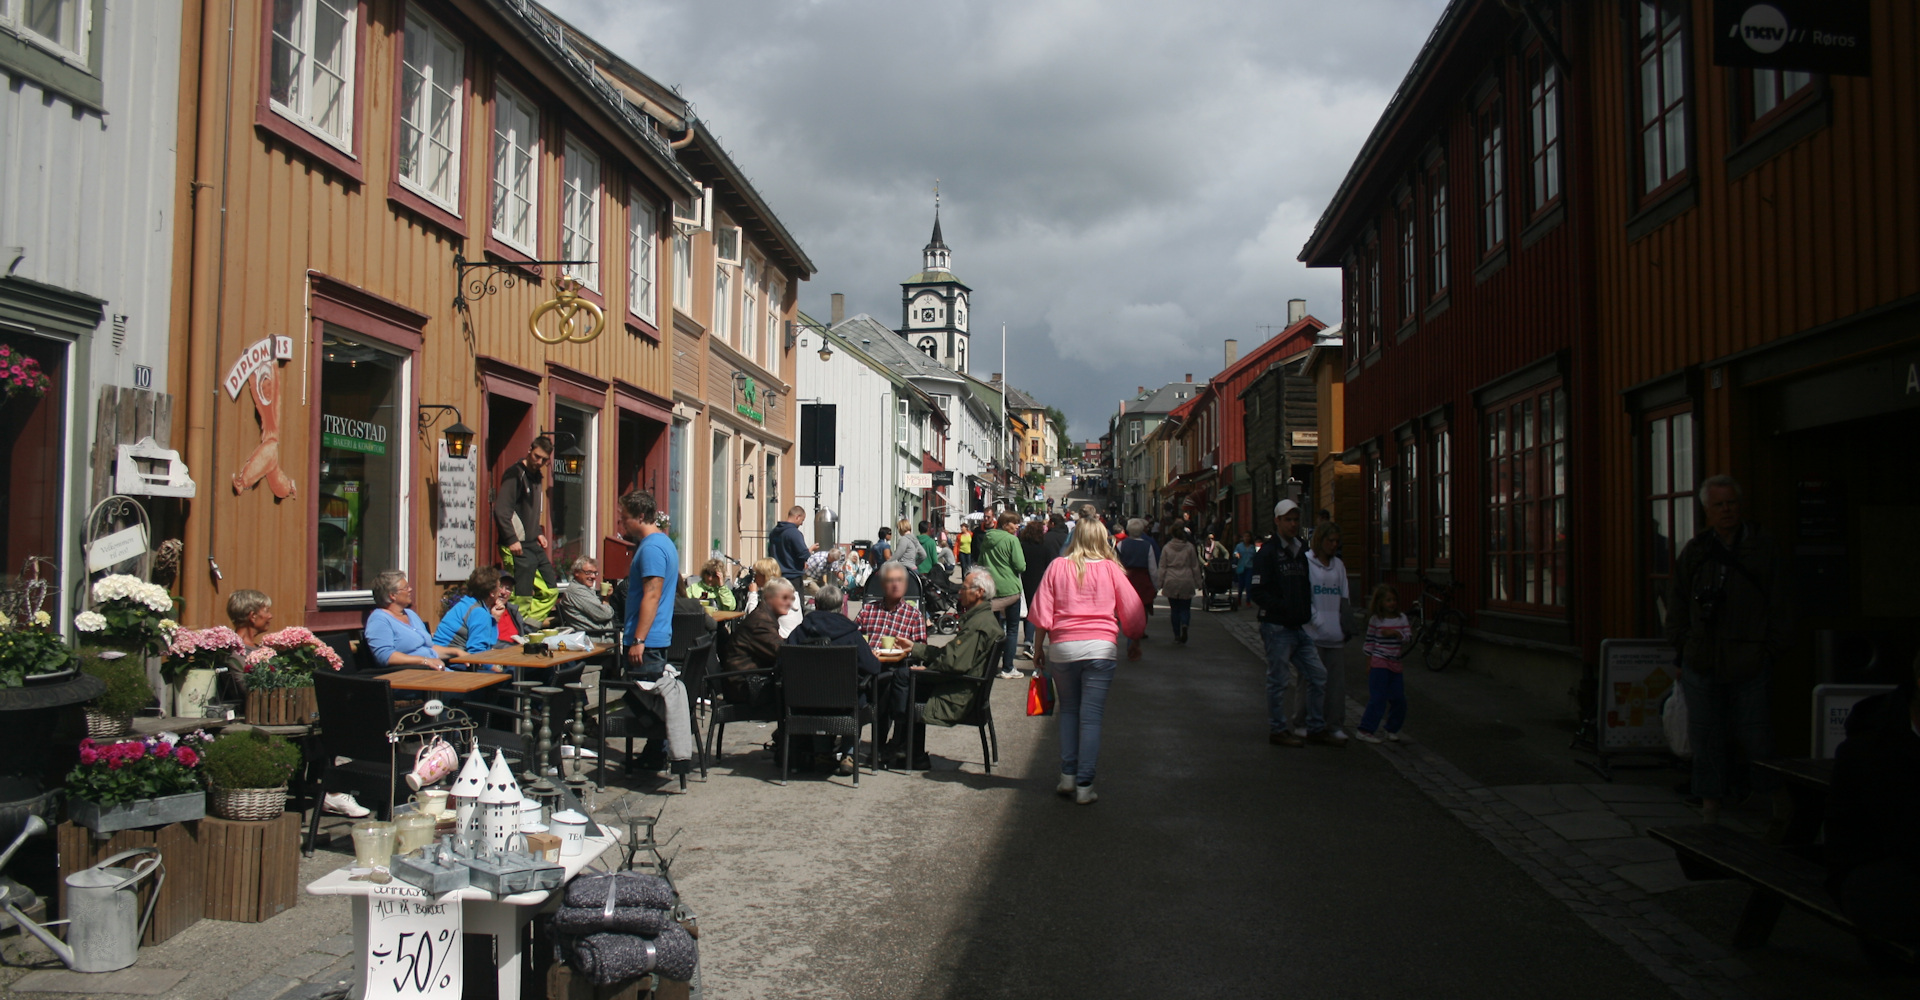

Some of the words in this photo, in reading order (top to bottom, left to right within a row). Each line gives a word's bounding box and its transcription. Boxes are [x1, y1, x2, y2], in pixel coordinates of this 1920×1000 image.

[1812, 30, 1856, 47] Røros
[230, 344, 269, 390] DIPLOM
[277, 340, 288, 354] IS
[137, 367, 150, 387] 10
[323, 414, 387, 443] TRYGSTAD
[333, 437, 353, 449] BAKERI
[568, 833, 583, 841] TEA
[375, 900, 394, 918] ALT
[399, 899, 410, 915] PÅ
[413, 903, 448, 916] BORDET
